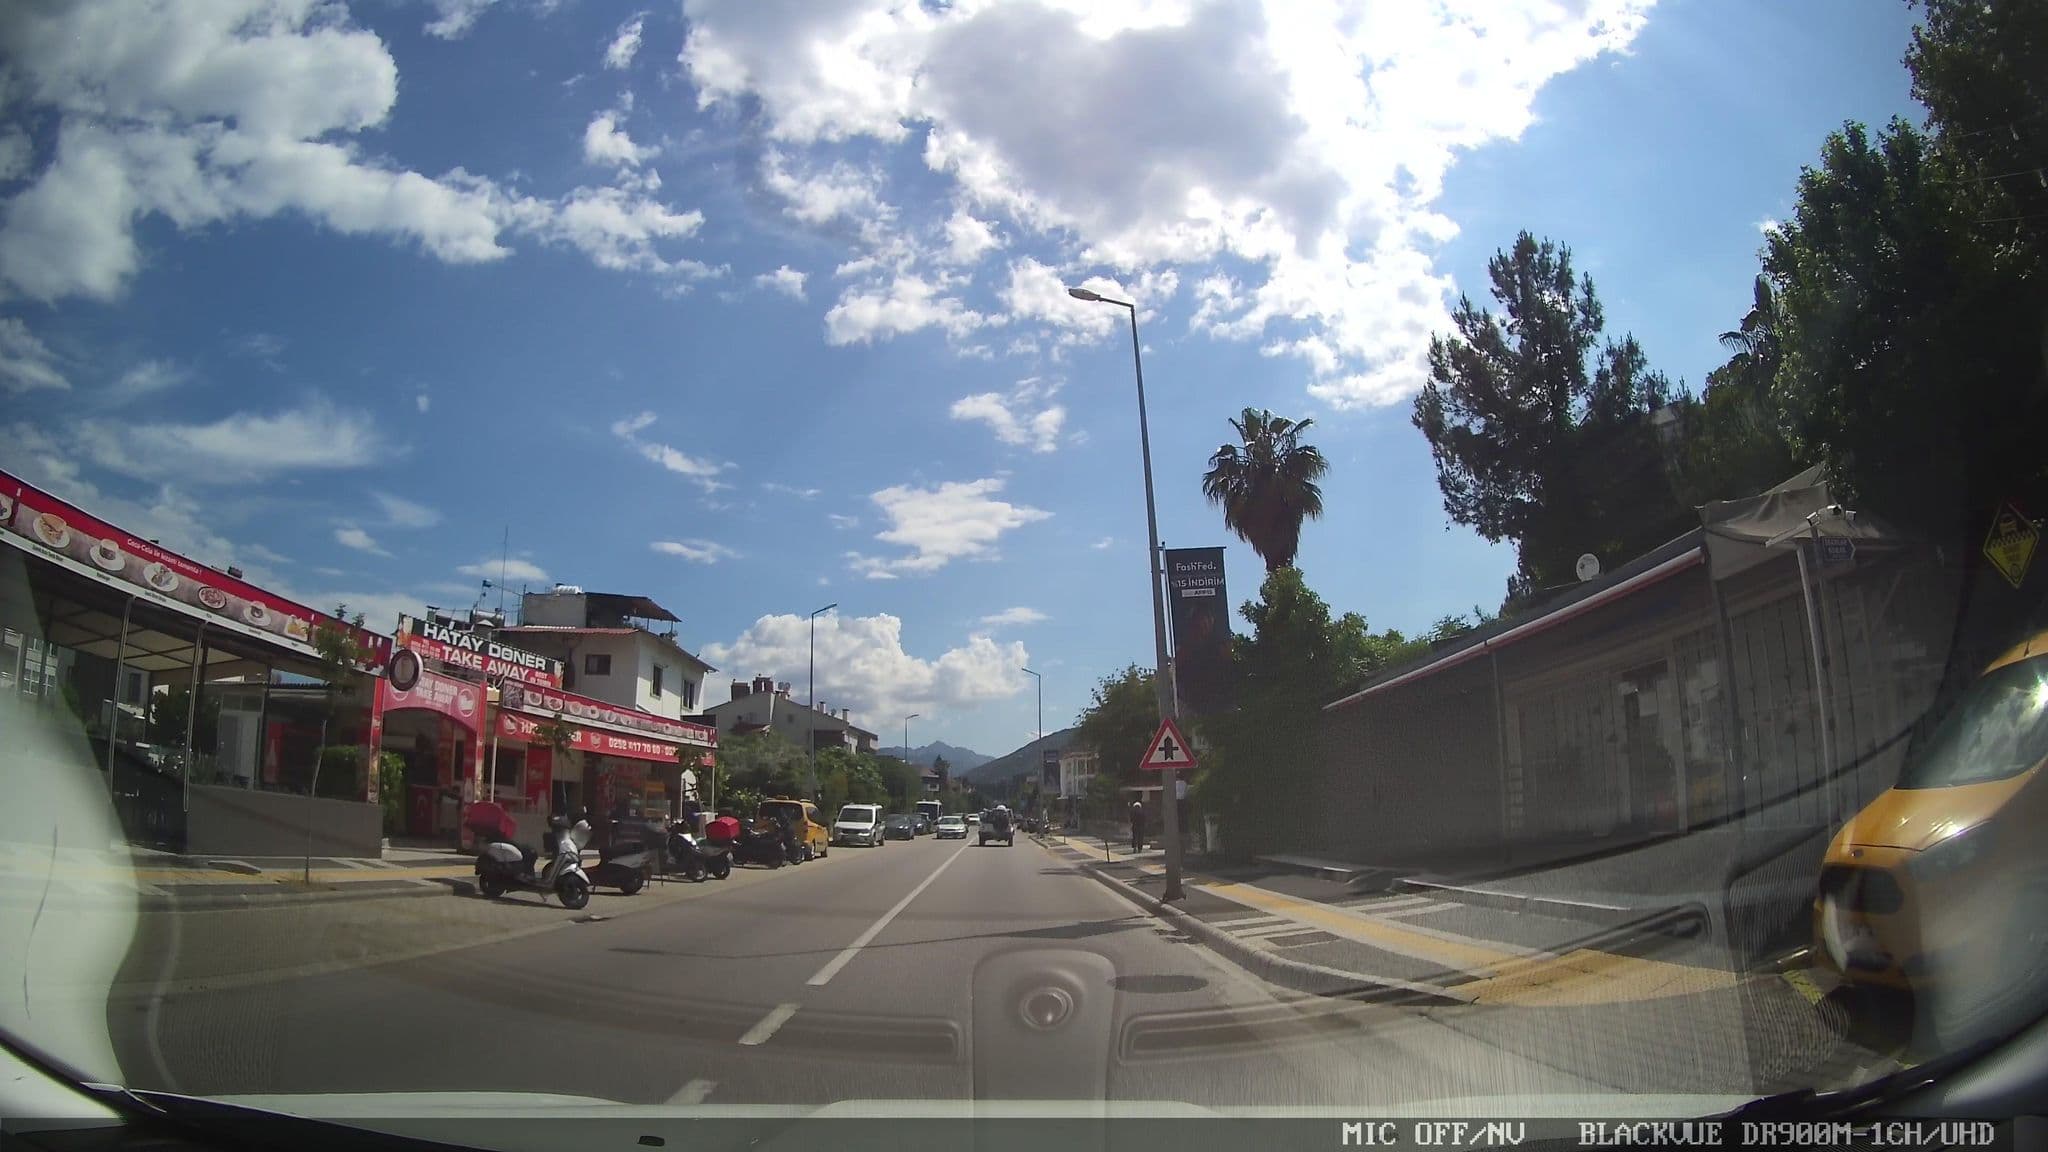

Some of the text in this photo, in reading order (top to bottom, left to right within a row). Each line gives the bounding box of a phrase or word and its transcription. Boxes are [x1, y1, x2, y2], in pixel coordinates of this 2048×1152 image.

[423, 623, 484, 652] HATAY
[441, 645, 482, 670] TAKE
[486, 660, 530, 682] AWAY
